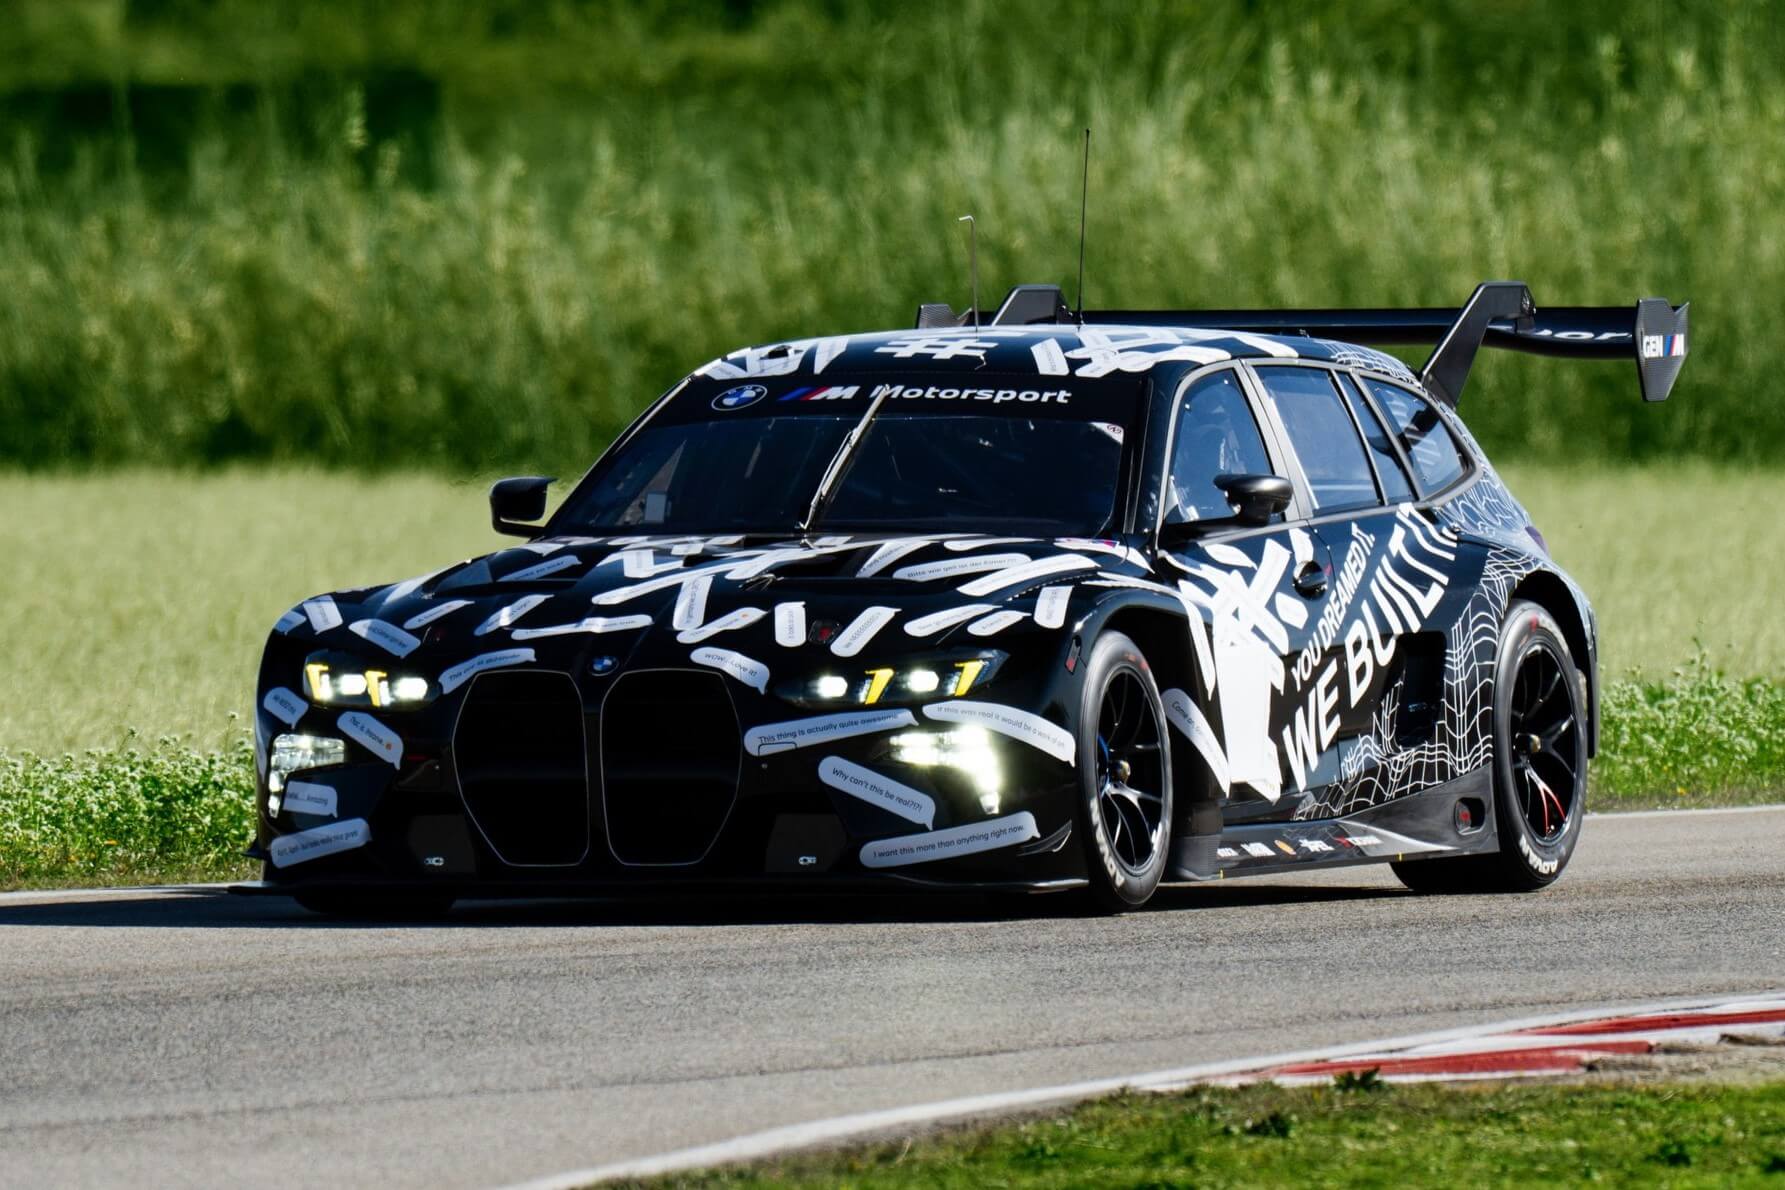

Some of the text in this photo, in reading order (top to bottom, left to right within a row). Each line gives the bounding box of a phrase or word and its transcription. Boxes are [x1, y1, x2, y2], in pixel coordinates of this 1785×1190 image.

[869, 384, 1072, 403] Motorsport
[1291, 632, 1321, 692] YOU
[1317, 540, 1367, 651] DREAMED
[1282, 658, 1341, 792] WE
[1345, 523, 1449, 709] BUILT
[758, 735, 776, 744] This
[777, 730, 798, 741] thing
[807, 723, 838, 735] actually
[839, 719, 860, 729] quite
[1001, 717, 1023, 729] would
[832, 767, 849, 782] Why
[849, 776, 869, 790] can't
[869, 784, 884, 796] this
[884, 790, 895, 801] be
[878, 849, 899, 858] want
[899, 846, 915, 855] this
[916, 843, 936, 853] more
[937, 839, 956, 849] than
[956, 832, 989, 847] anything
[990, 827, 1008, 840] right
